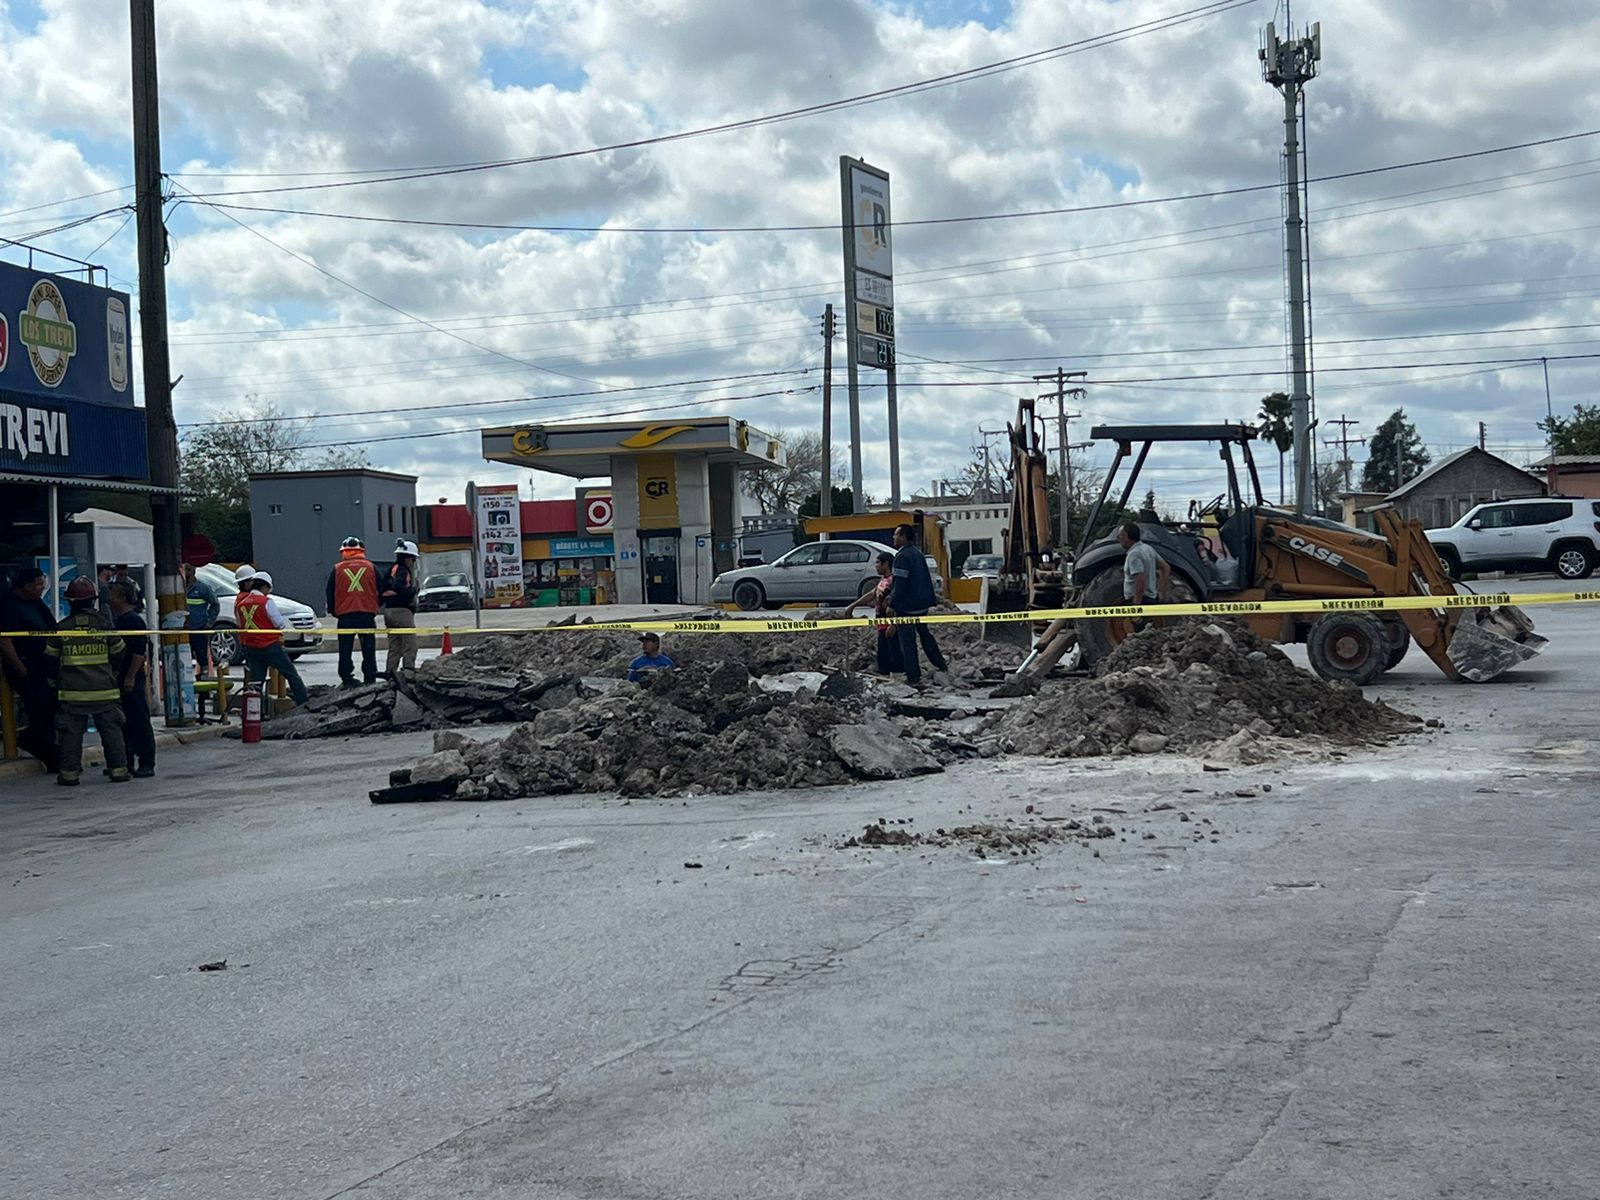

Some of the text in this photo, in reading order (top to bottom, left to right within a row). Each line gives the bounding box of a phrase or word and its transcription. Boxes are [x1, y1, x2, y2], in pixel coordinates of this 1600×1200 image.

[23, 318, 73, 348] LOS TREVI
[512, 429, 548, 451] CR
[645, 481, 669, 496] CR
[1289, 537, 1344, 566] CASE
